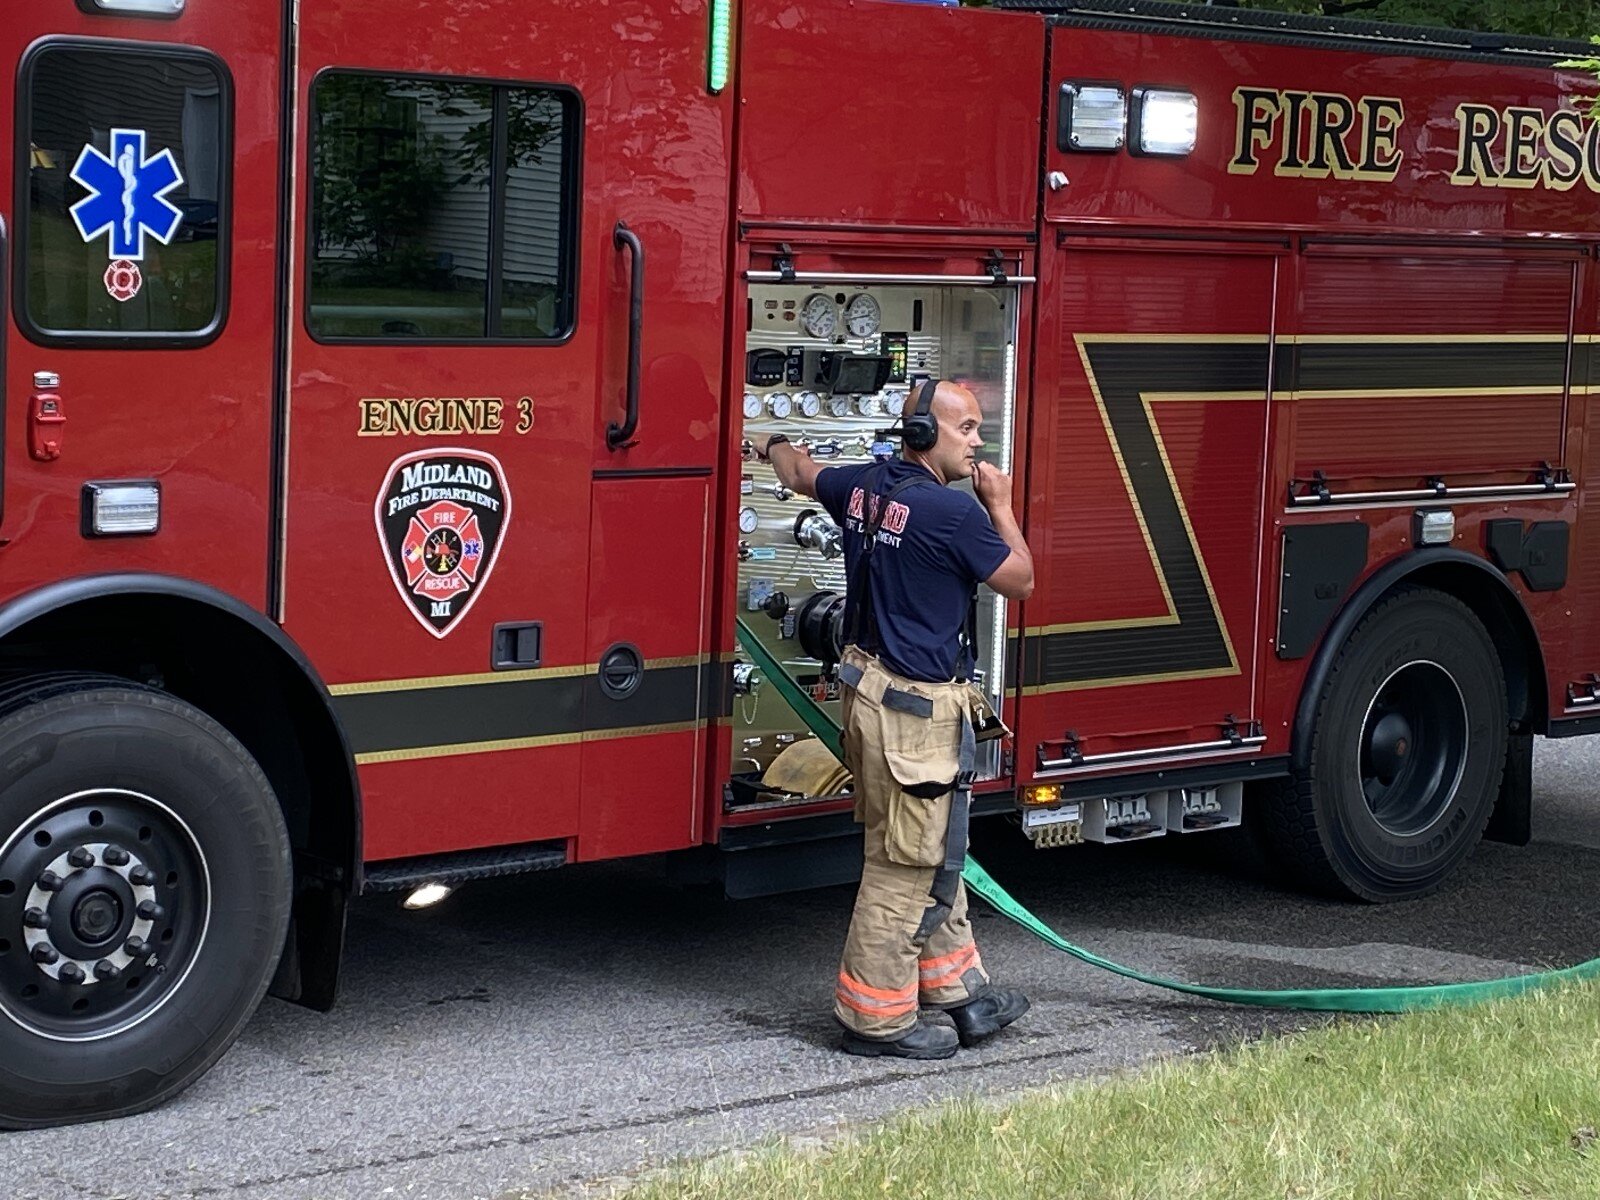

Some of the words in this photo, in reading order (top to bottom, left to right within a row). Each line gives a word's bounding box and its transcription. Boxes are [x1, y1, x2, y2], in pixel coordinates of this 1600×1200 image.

[1227, 86, 1404, 182] FIRE
[357, 397, 504, 436] ENGINE
[516, 396, 535, 434] 3
[401, 461, 492, 492] MIDLAND
[388, 492, 419, 516] FIRE
[421, 487, 500, 512] DEPARTMENT
[433, 512, 456, 524] FIRE
[424, 577, 462, 590] RESCUE
[431, 602, 452, 617] MI
